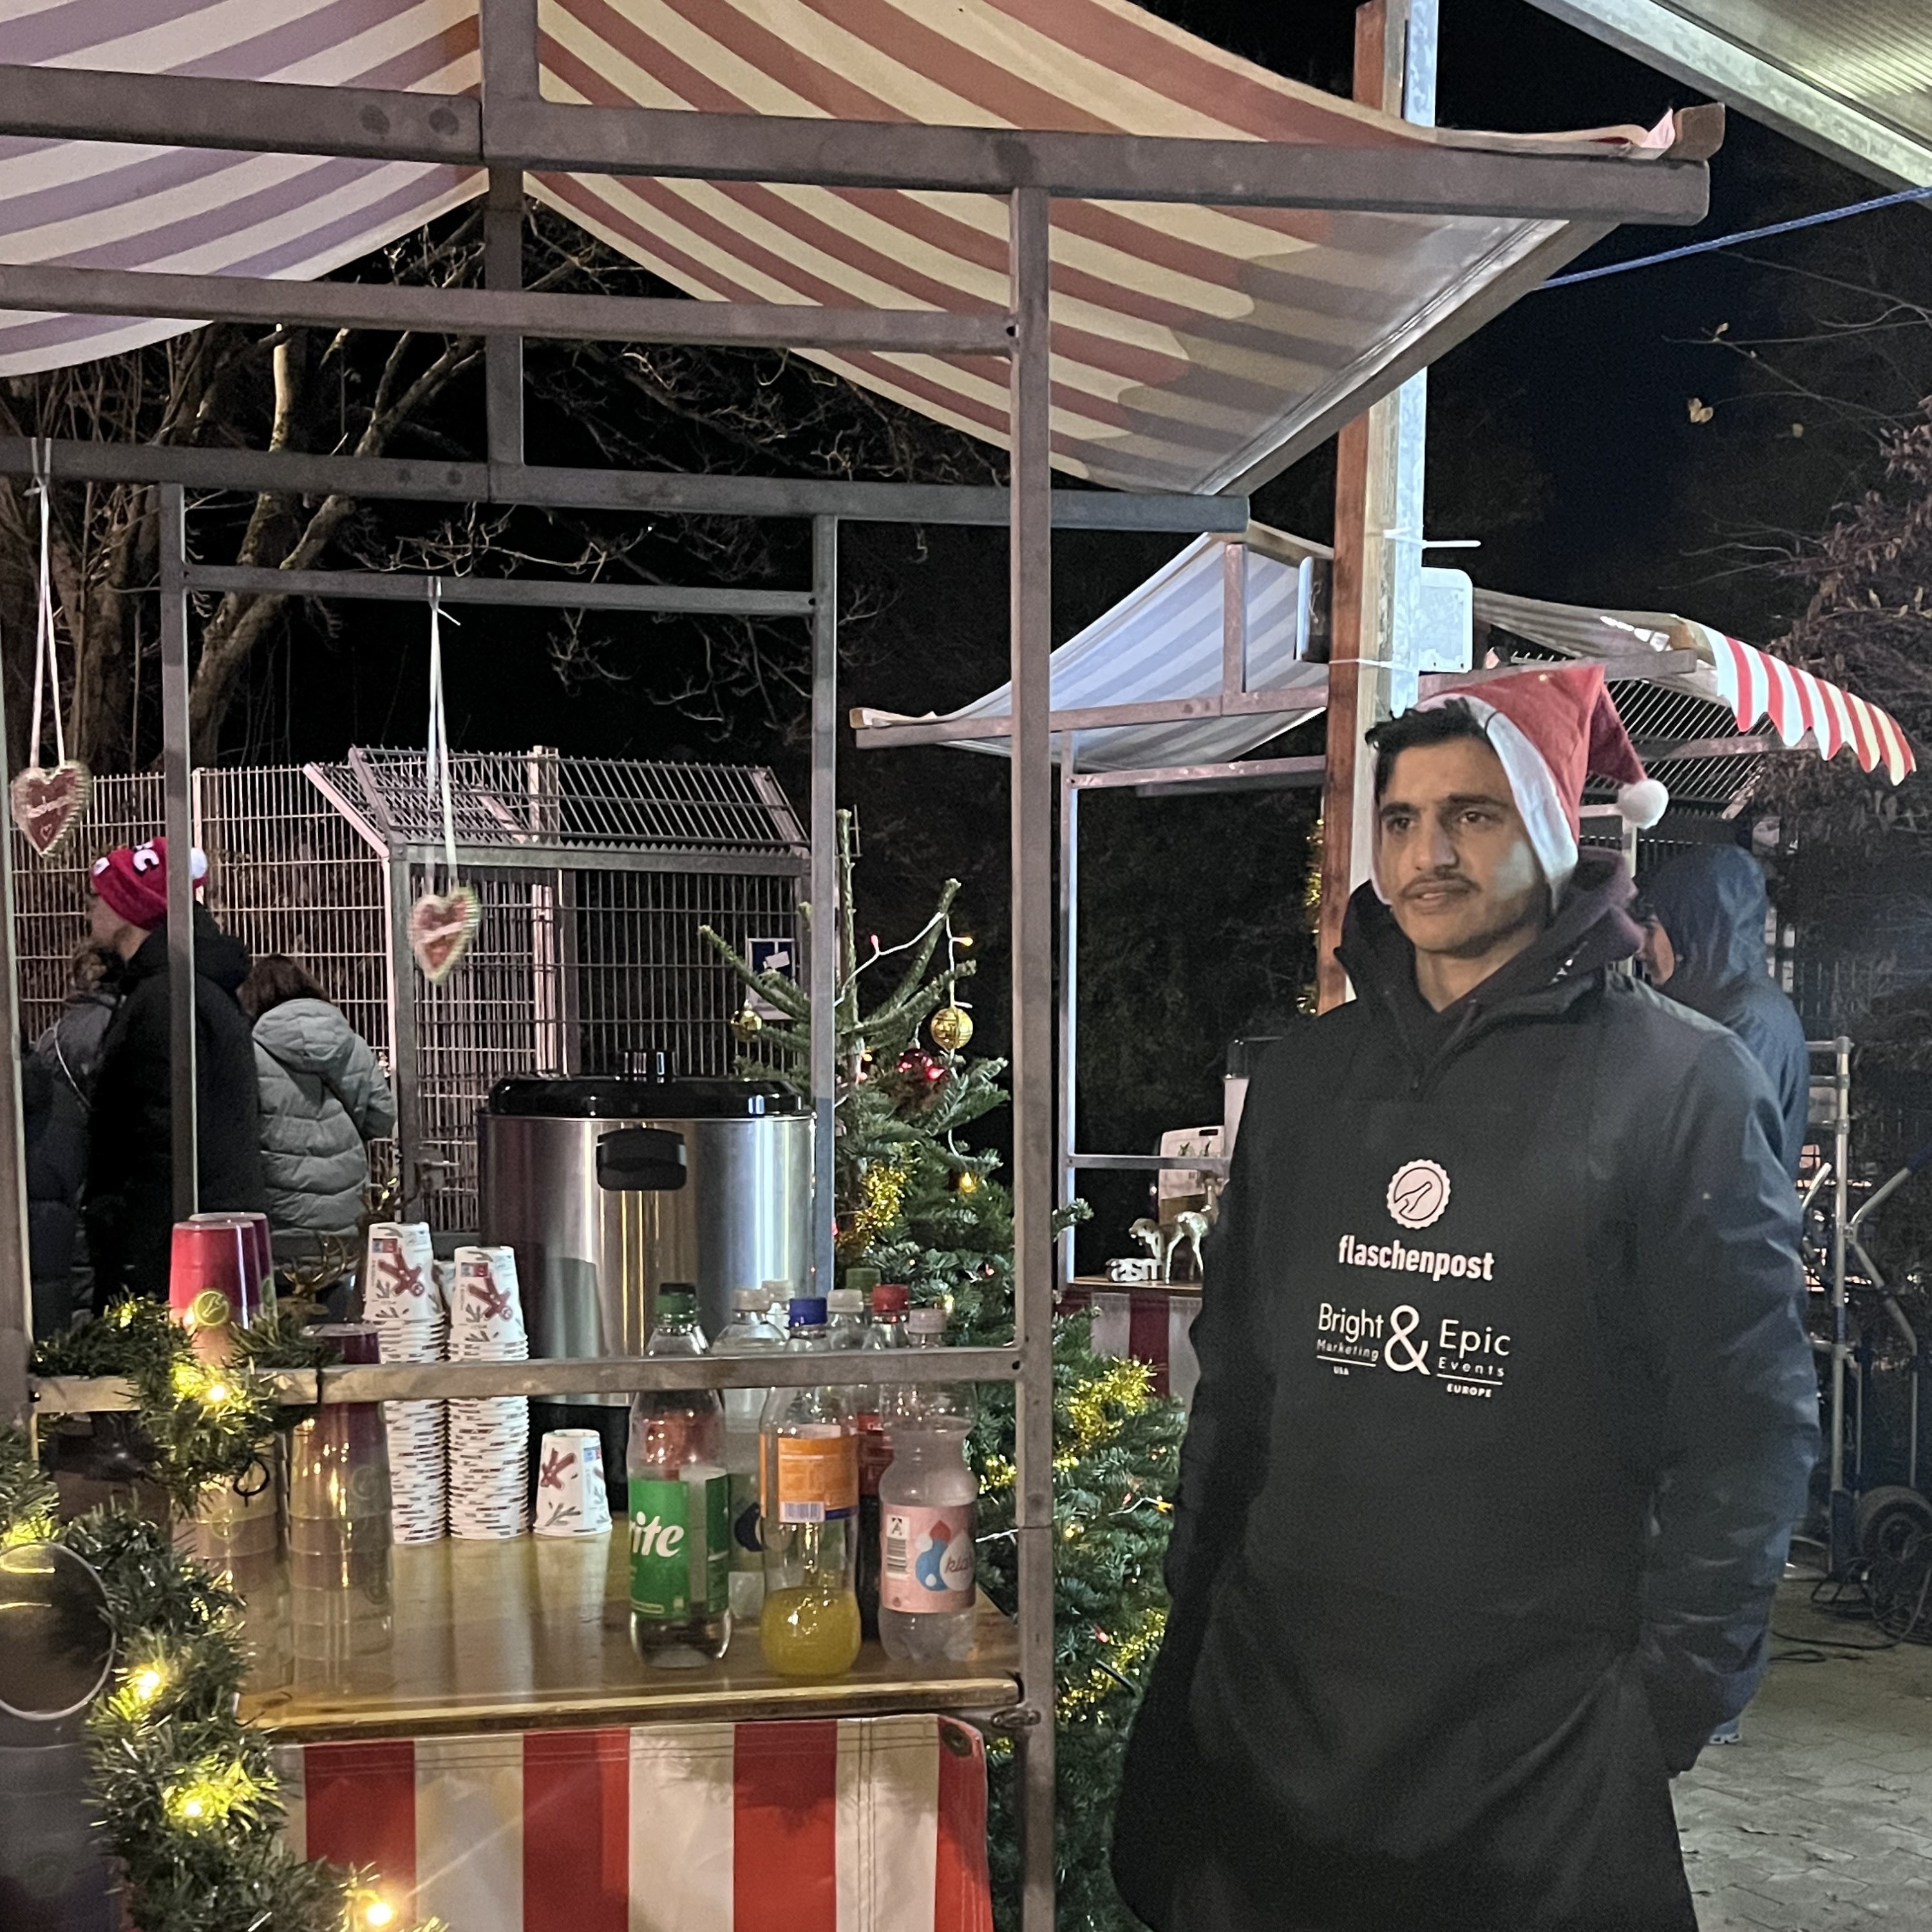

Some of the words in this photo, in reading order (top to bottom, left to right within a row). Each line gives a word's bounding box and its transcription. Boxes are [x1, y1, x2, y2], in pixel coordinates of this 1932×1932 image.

[1338, 1234, 1495, 1282] flaschenpost
[1316, 1339, 1379, 1362] Marketing
[1318, 1303, 1384, 1343] Bright
[1384, 1305, 1431, 1376] &
[1439, 1319, 1511, 1359] Epic
[1438, 1356, 1504, 1377] Events
[1446, 1383, 1492, 1397] EUROPE
